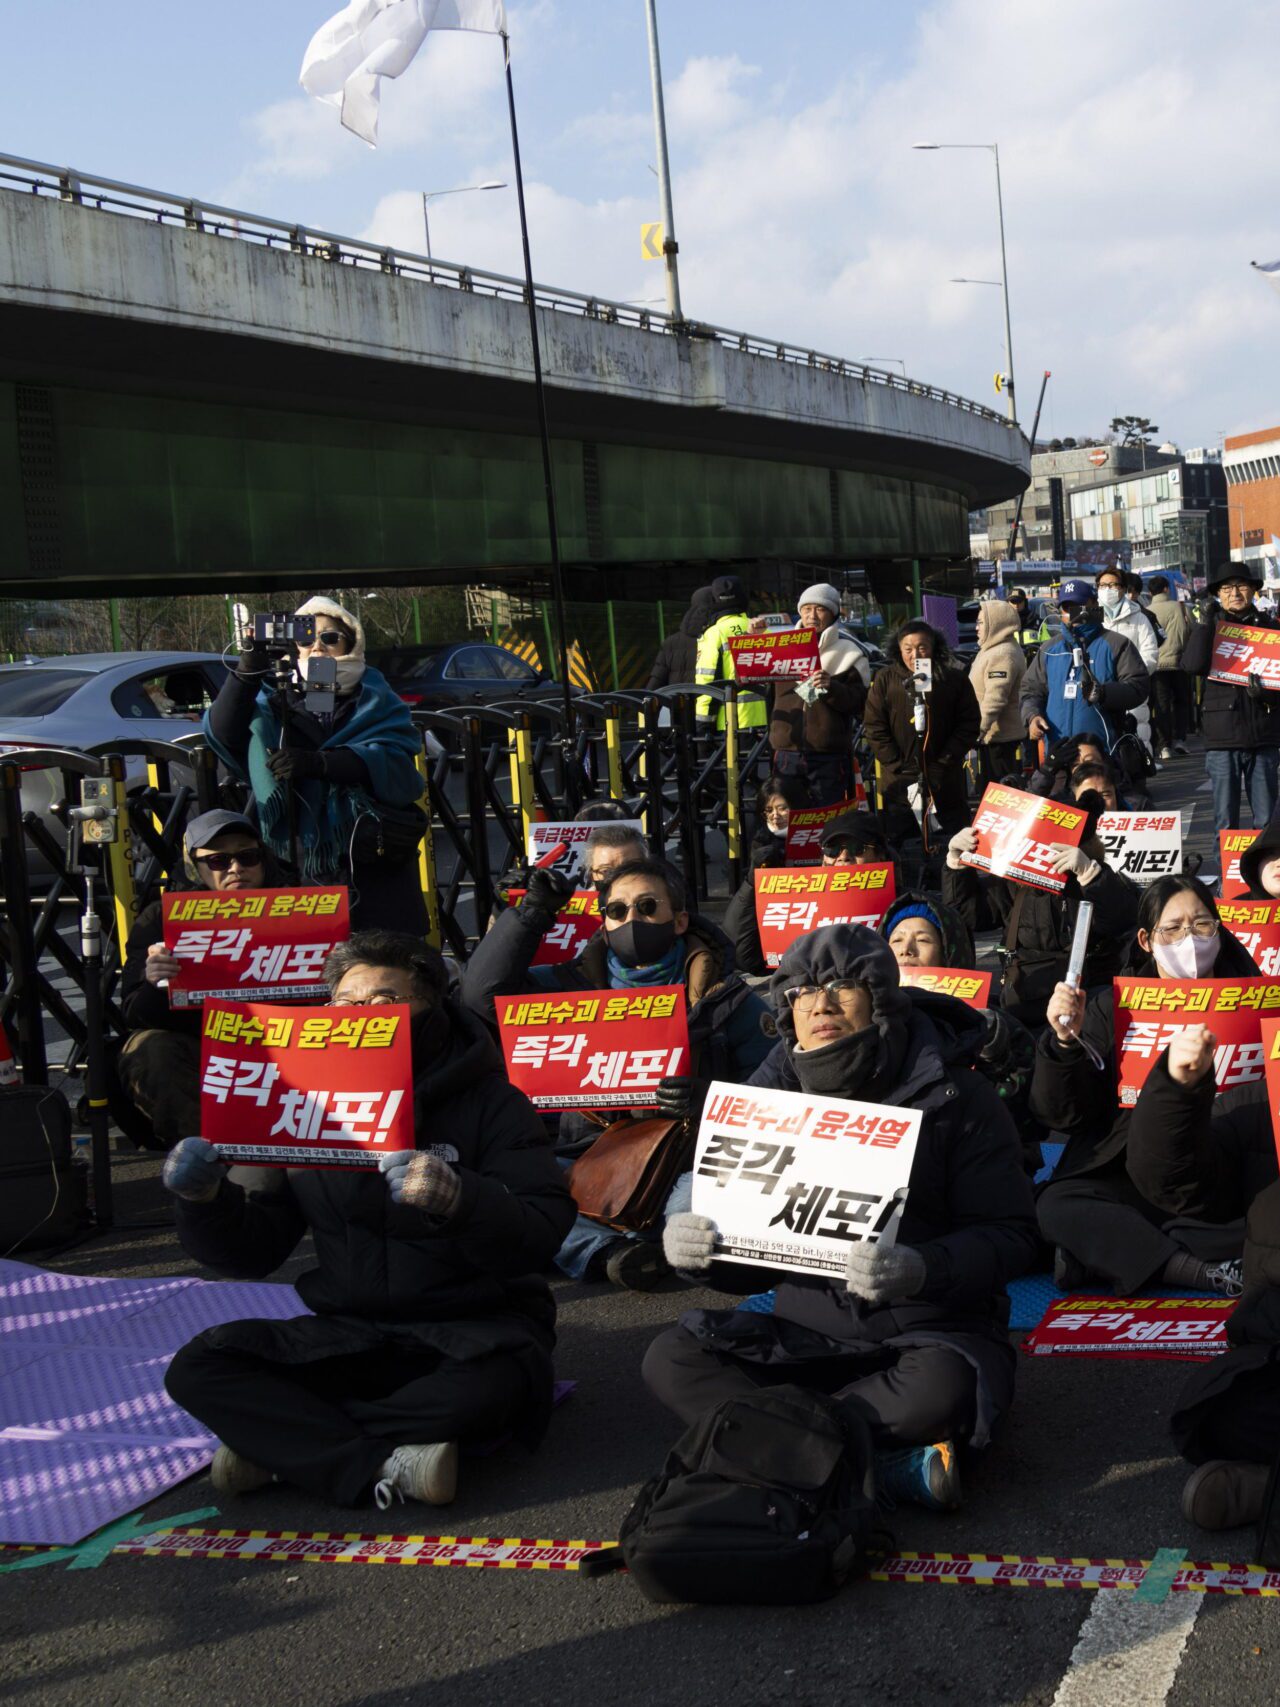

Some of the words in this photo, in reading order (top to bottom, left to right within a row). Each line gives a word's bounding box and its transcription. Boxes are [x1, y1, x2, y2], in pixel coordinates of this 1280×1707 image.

[730, 625, 743, 636] 경
[765, 616, 780, 624] AXI
[732, 636, 776, 649] 내란수괴
[779, 632, 813, 646] 윤석열
[1219, 625, 1264, 643] 내란수괴
[1216, 641, 1254, 662] 즉각
[737, 652, 772, 666] 즉각
[770, 656, 817, 674] 체포!
[790, 811, 837, 826] 내란수괴
[983, 788, 1033, 815] 내란수괴
[1033, 804, 1082, 830] 윤석열
[1133, 817, 1176, 831] 윤석열
[1121, 849, 1179, 874] 체포!
[758, 871, 827, 895] 내란수괴
[829, 868, 889, 892] 윤석열
[168, 896, 268, 921] 내란수괴
[269, 893, 341, 917] 윤석열
[762, 901, 819, 930] 즉각
[1216, 904, 1272, 925] 란수괴
[172, 928, 253, 963] 즉각
[239, 941, 343, 983] 체포
[915, 974, 984, 1001] 윤석열
[502, 999, 600, 1026] 내란수괴
[603, 993, 678, 1022] 윤석열
[1119, 986, 1214, 1012] 내란수괴
[204, 1009, 295, 1049] 내란수괴
[297, 1015, 401, 1049] 윤석열
[511, 1033, 588, 1069] 즉각
[579, 1046, 684, 1088] 체포!
[202, 1055, 281, 1107] 즉각
[269, 1089, 405, 1144] 체포!
[810, 1109, 911, 1149] 윤석열
[697, 1134, 796, 1195] 즉각
[768, 1182, 904, 1243] 체포!
[740, 1236, 769, 1250] 탄핵기금
[771, 1242, 784, 1251] 5억
[786, 1244, 800, 1254] 모금
[1052, 1300, 1154, 1311] 내란수괴
[1046, 1312, 1136, 1331] 즉각
[1112, 1320, 1226, 1341] 체포!
[159, 1534, 250, 1551] DANGER!
[262, 1538, 353, 1554] 안전제일
[412, 1542, 461, 1559] 위험
[509, 1545, 598, 1563] ANGER!
[995, 1563, 1087, 1583] 안전제일
